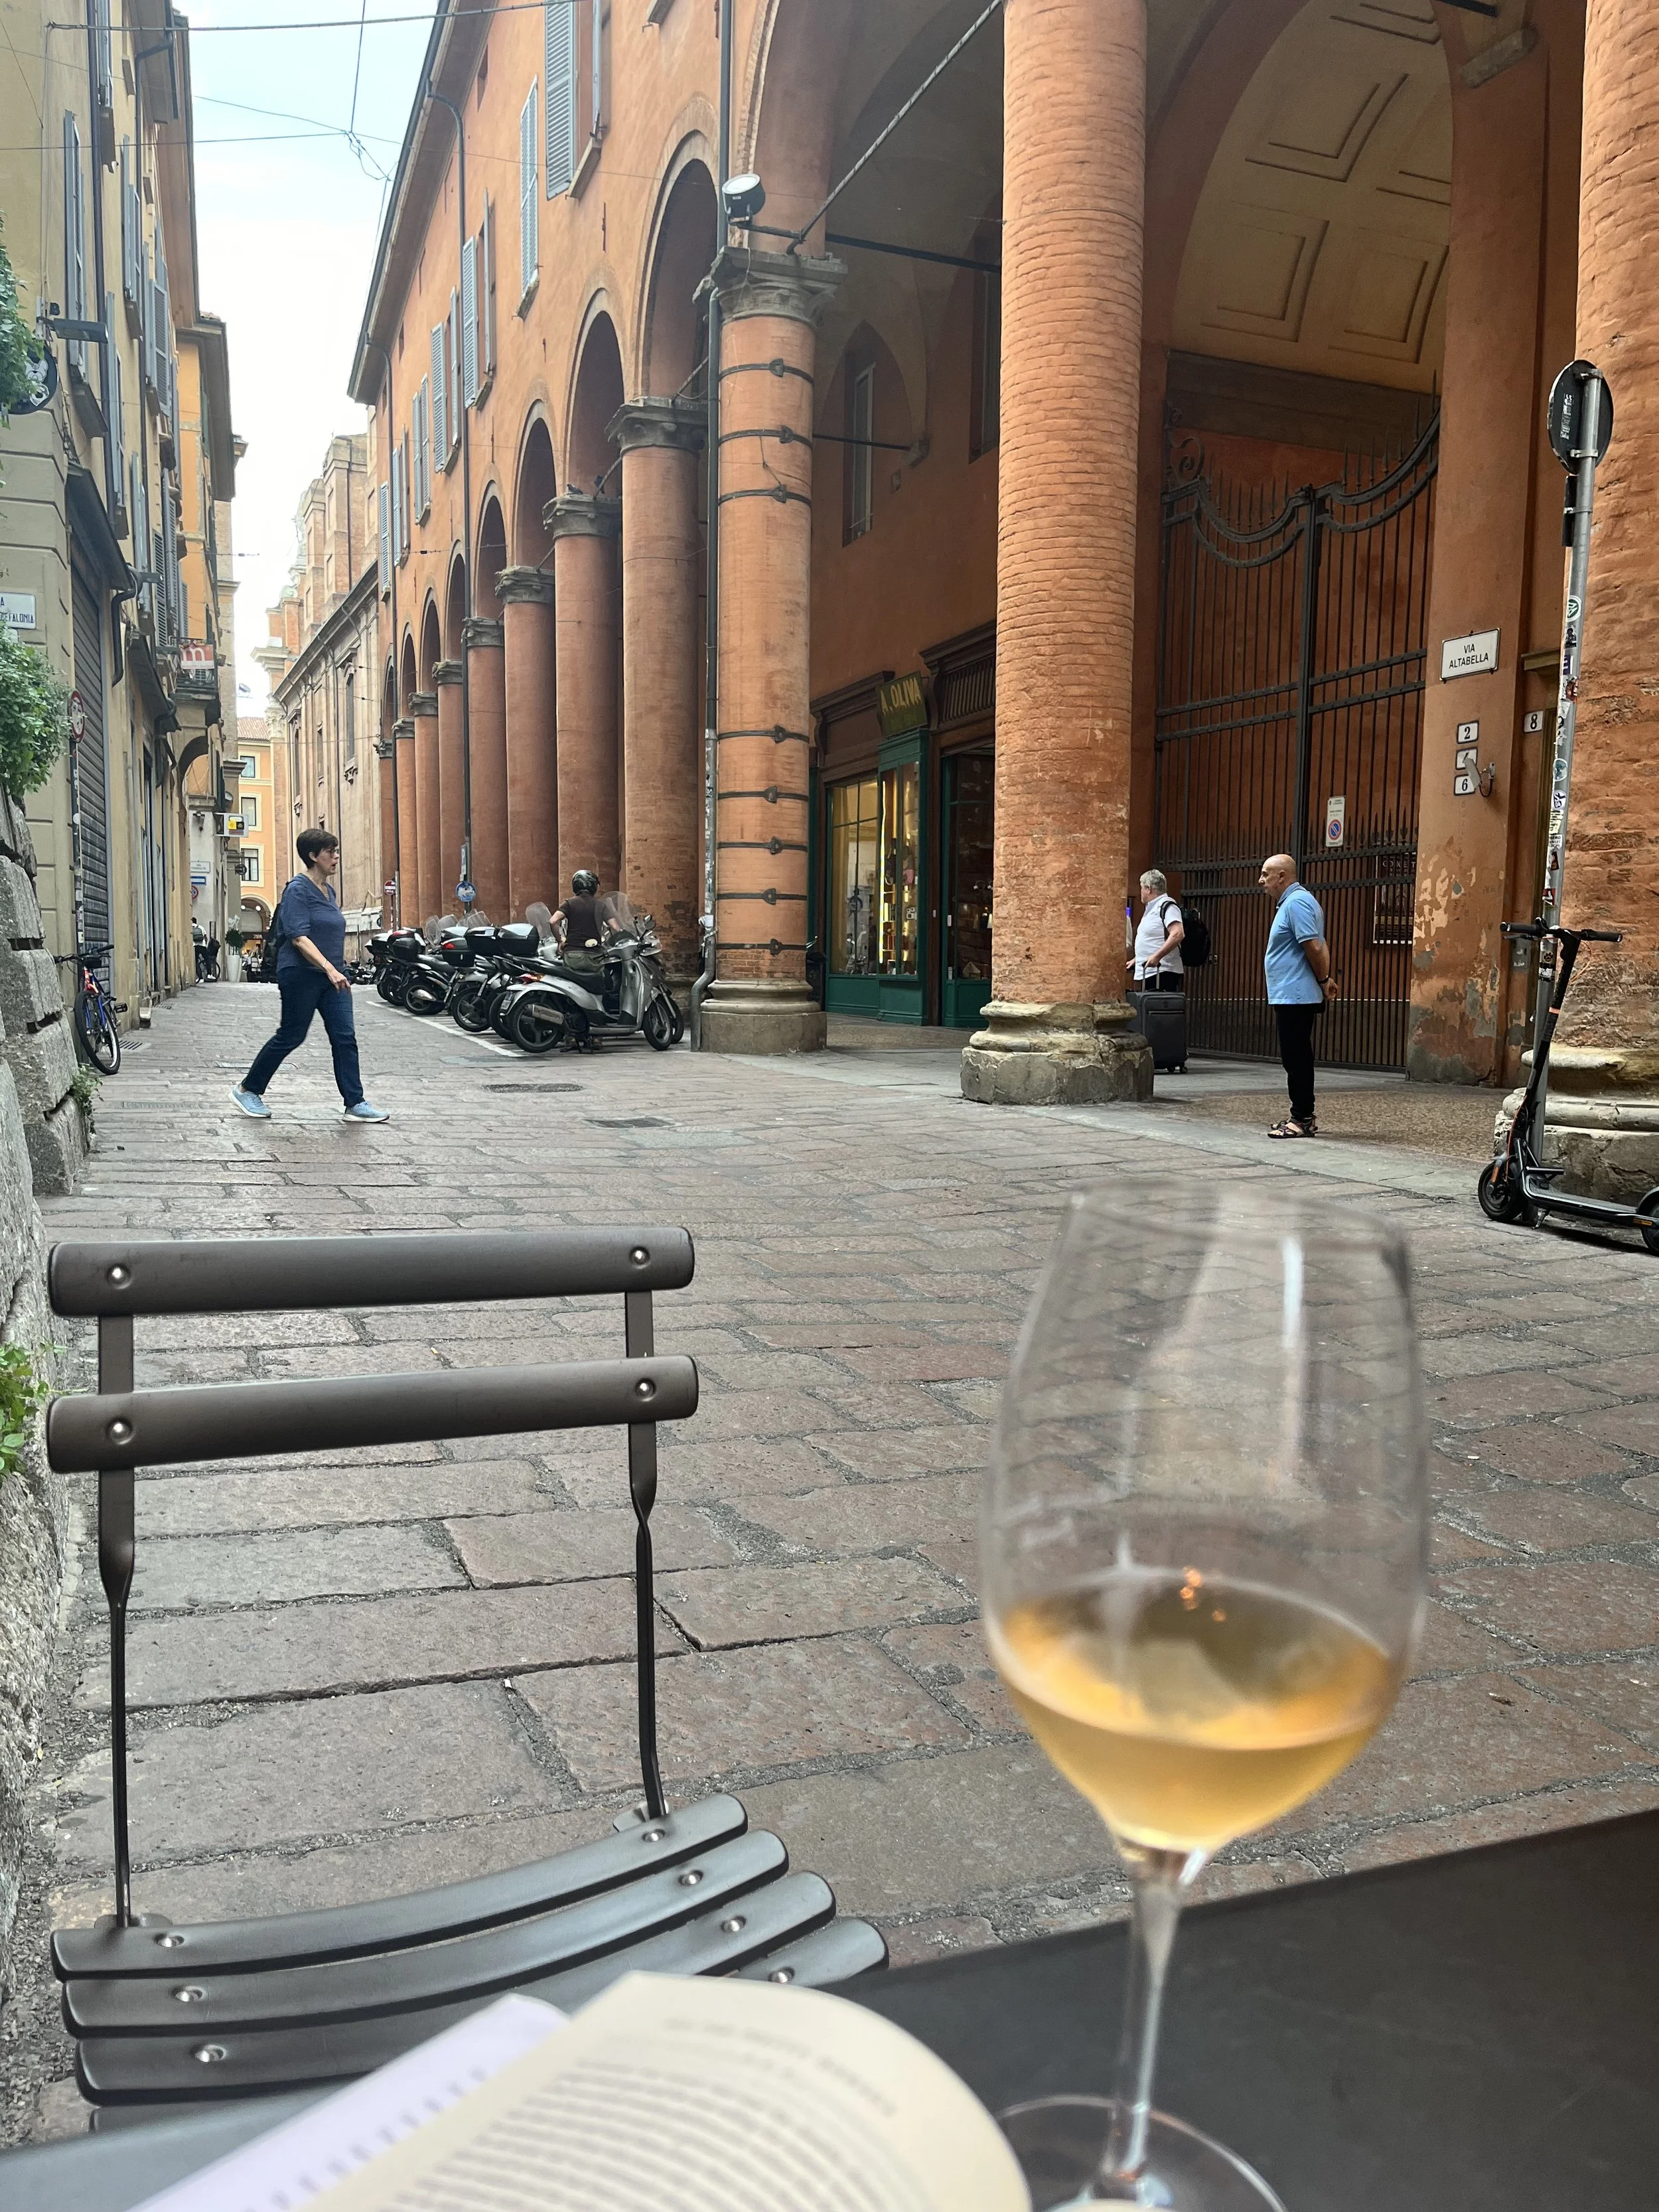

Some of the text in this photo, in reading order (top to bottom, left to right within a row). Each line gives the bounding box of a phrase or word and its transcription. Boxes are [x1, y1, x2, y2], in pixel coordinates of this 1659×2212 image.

[1464, 643, 1475, 654] VIA
[1449, 652, 1488, 669] ALTABELLA
[890, 677, 922, 709] OLIVA
[1530, 713, 1538, 729] 8
[1464, 726, 1471, 739] 2
[1461, 778, 1468, 791] 6
